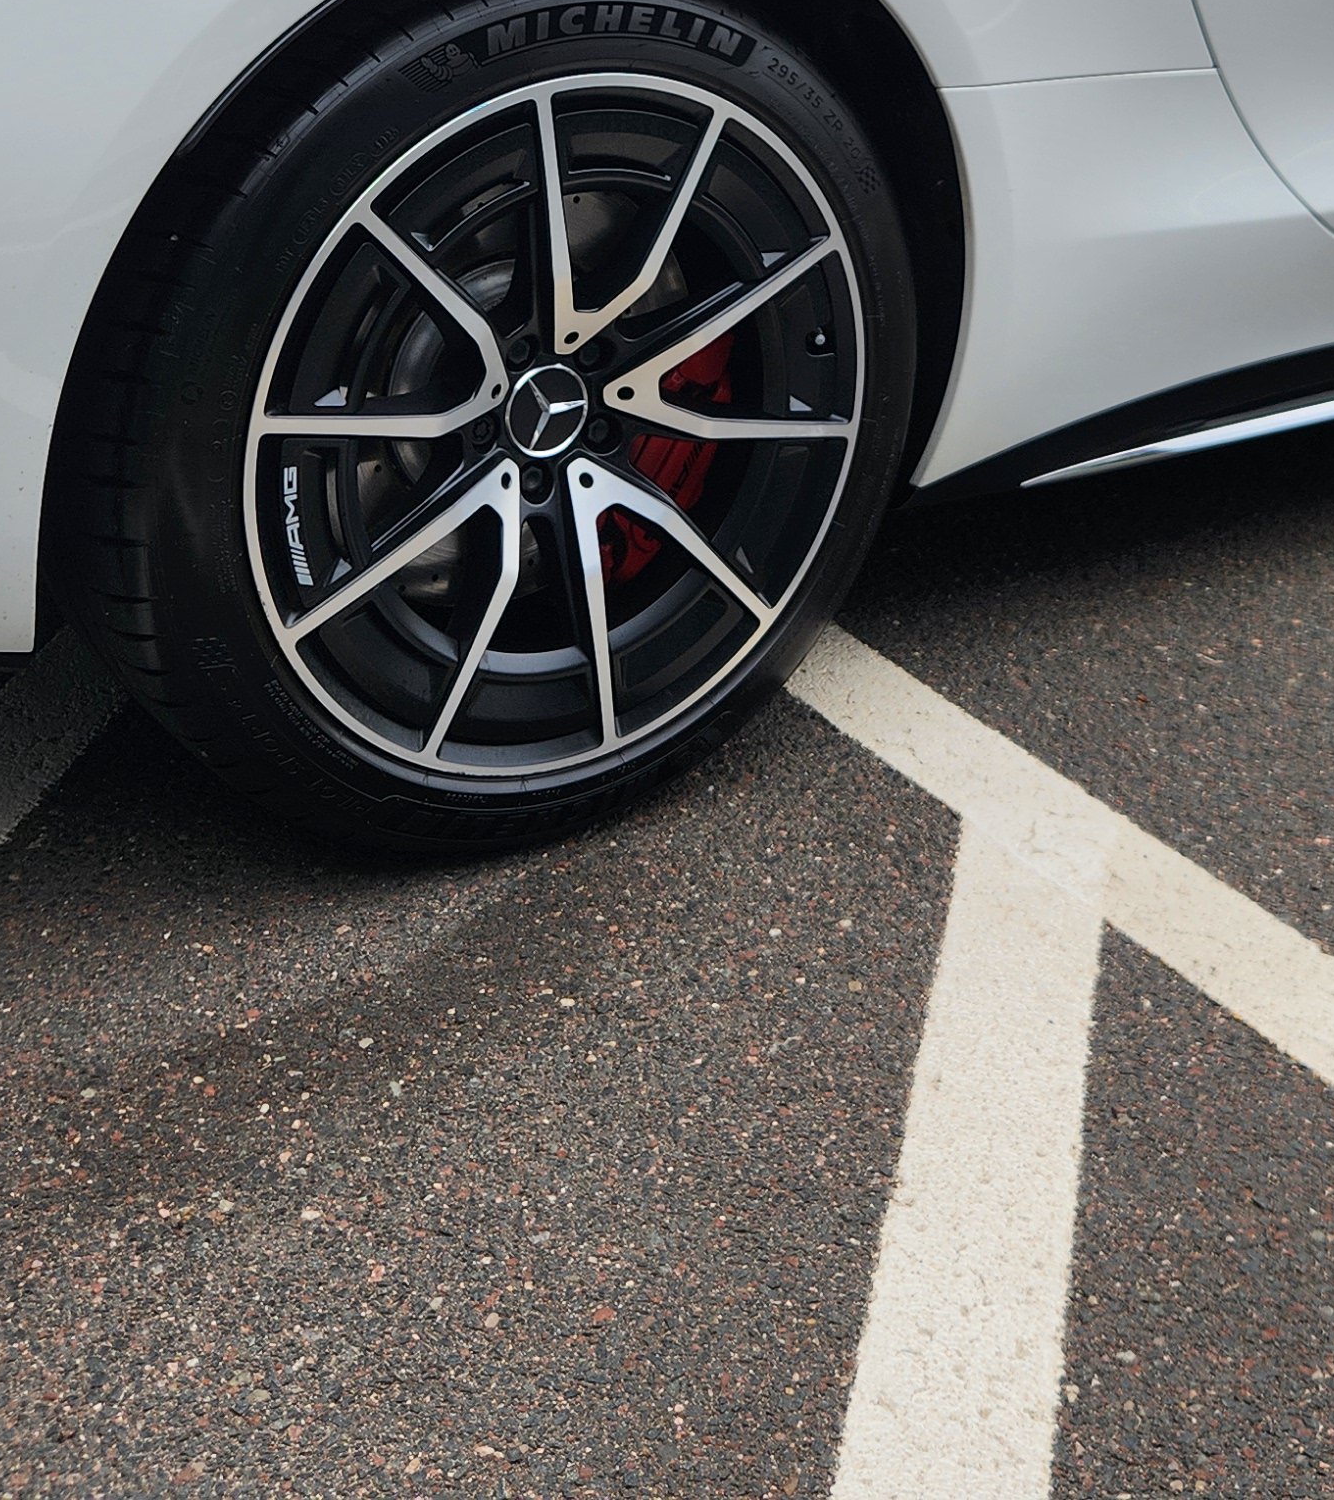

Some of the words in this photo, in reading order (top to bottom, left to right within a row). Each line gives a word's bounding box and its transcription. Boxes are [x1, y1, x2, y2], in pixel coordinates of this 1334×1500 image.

[485, 3, 745, 58] MICHELIN
[767, 57, 824, 109] 295/35
[823, 109, 844, 132] ZR
[844, 137, 862, 160] 20
[283, 466, 305, 551] AMG
